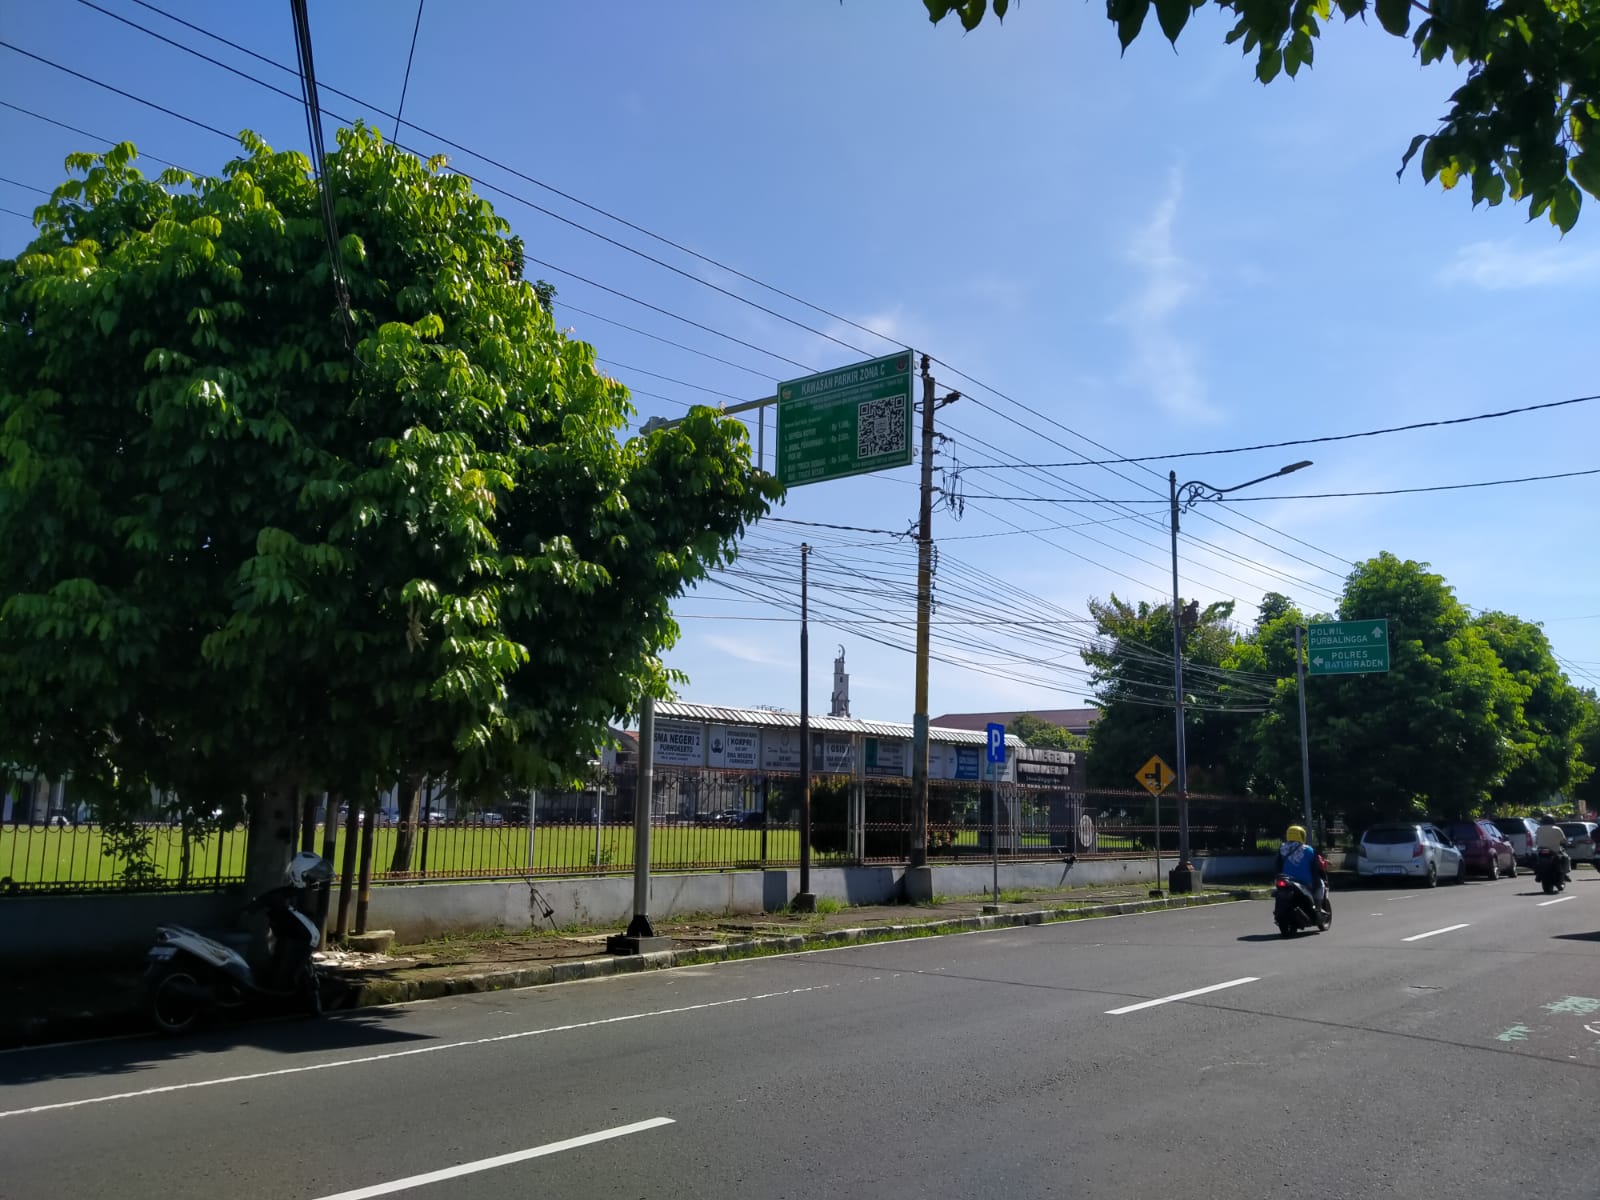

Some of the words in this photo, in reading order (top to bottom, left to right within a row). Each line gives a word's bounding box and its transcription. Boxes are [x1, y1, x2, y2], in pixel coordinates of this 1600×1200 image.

[801, 378, 832, 396] KAWASAN
[834, 372, 858, 387] PARKIR
[860, 366, 879, 381] ZONA
[1310, 627, 1344, 636] POLWIL
[1311, 635, 1368, 645] PURBALINGGA
[1331, 650, 1368, 660] POLRES
[670, 733, 695, 746] NEGERI
[991, 729, 1000, 755] P
